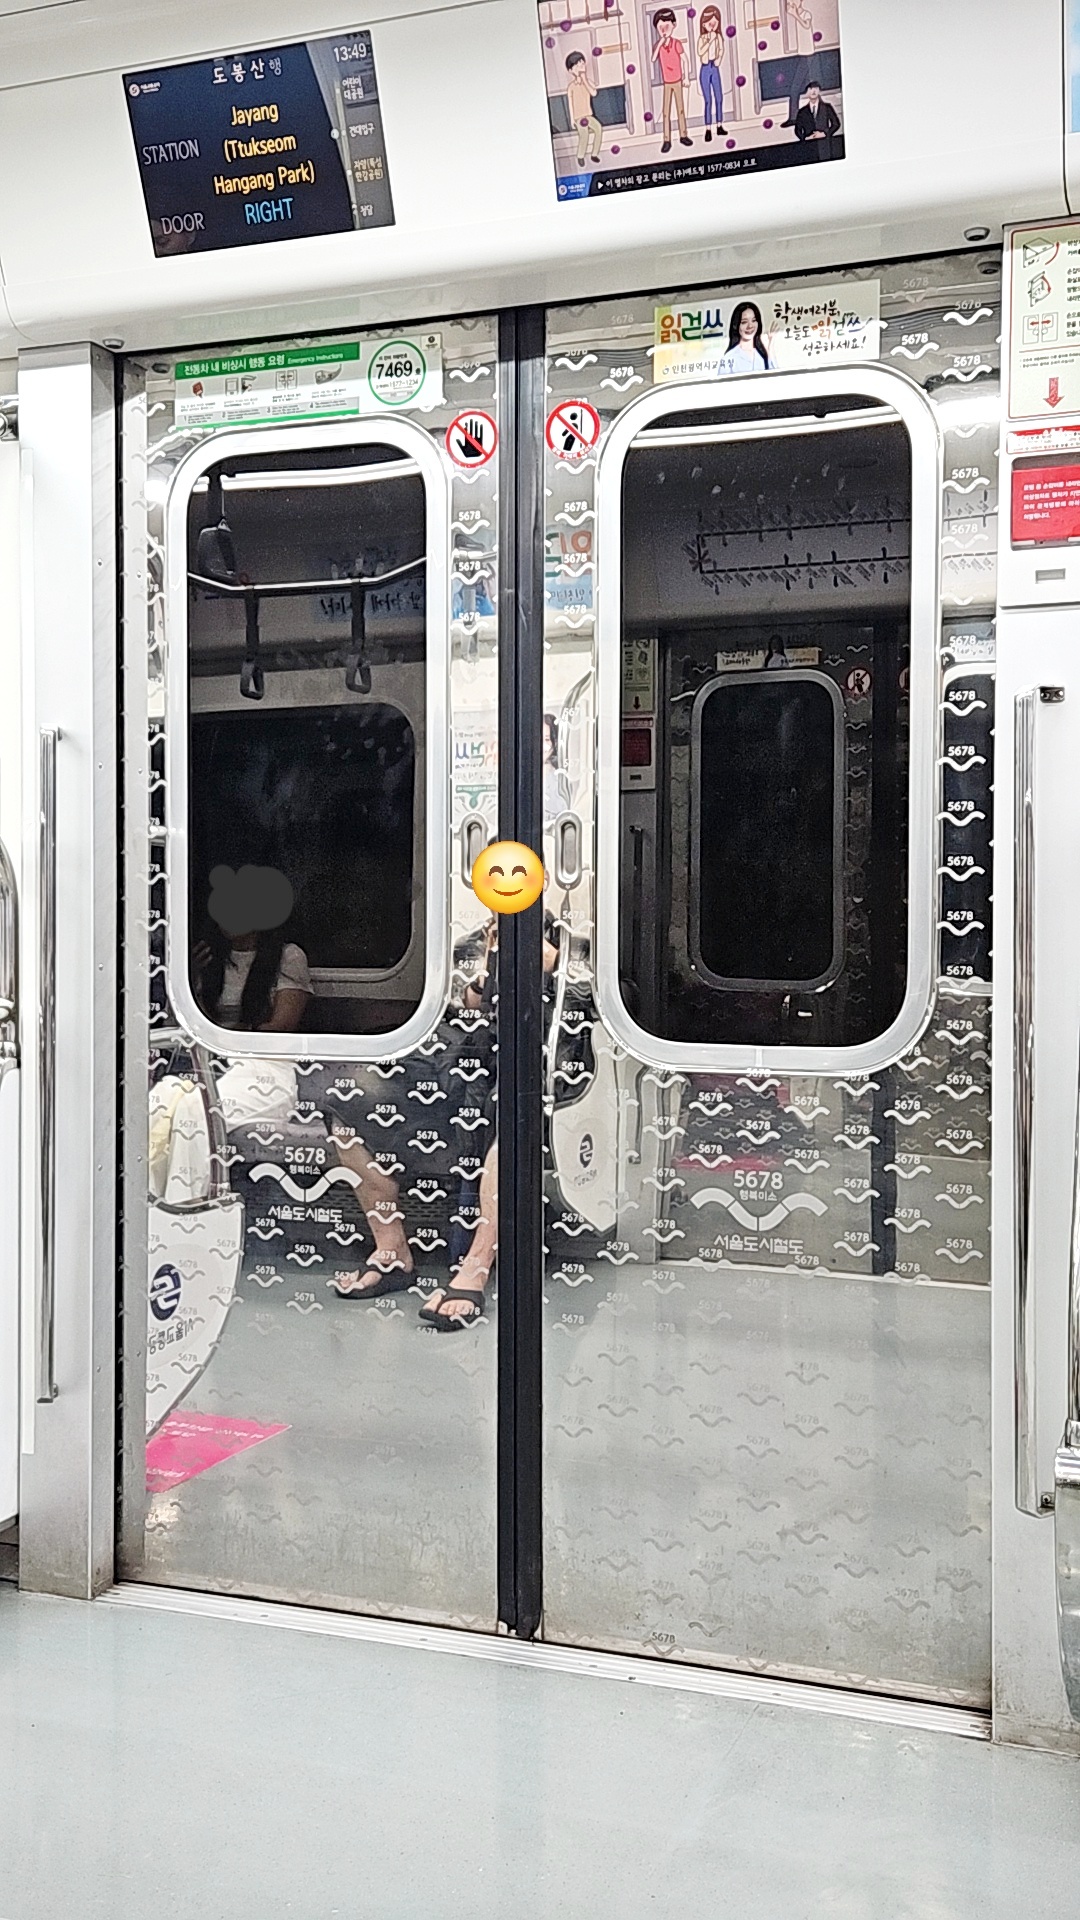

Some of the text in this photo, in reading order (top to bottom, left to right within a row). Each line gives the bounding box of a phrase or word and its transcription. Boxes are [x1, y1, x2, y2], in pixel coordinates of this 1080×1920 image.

[334, 43, 367, 62] 13:49
[342, 76, 362, 89] 어린이
[231, 103, 278, 127] Jayang
[142, 138, 200, 165] STATION
[223, 134, 297, 163] (Ttukseom
[213, 160, 315, 195] Hangang Park)
[244, 198, 293, 225] RIGHT
[160, 211, 206, 236] DOOR
[903, 277, 929, 289] 5678
[660, 308, 724, 344] 읽걷쓰
[784, 325, 811, 341] 오늘도
[901, 332, 929, 346] 5678
[802, 336, 867, 358] 성공하세요!
[953, 355, 981, 368] 5678
[184, 361, 209, 376] 전동차
[375, 360, 413, 379] 7469
[610, 366, 634, 378] 5678
[951, 467, 979, 479] 5678
[564, 502, 588, 513] 5678
[459, 511, 481, 521] 5678
[951, 524, 978, 535] 5678
[564, 553, 588, 563] 5678
[459, 561, 481, 571] 5678
[563, 604, 588, 615] 5678
[459, 613, 481, 622] 5678
[949, 635, 977, 646] 5678
[948, 690, 976, 701] 5678
[947, 746, 976, 757] 5678
[946, 801, 975, 812] 5678
[945, 856, 974, 867] 5678
[562, 910, 585, 920] 5678
[946, 911, 974, 921] 5678
[459, 960, 480, 970] 5678
[946, 966, 973, 977] 5678
[459, 1009, 481, 1019] 5678
[562, 1011, 585, 1021] 5678
[946, 1020, 973, 1031] 5678
[459, 1059, 481, 1069] 5678
[562, 1061, 585, 1071] 5678
[179, 1073, 198, 1082] 5678
[256, 1076, 276, 1085] 5678
[946, 1074, 973, 1085] 5678
[334, 1079, 355, 1089] 5678
[416, 1082, 438, 1092] 5678
[216, 1098, 237, 1107] 5678
[699, 1092, 723, 1103] 5678
[794, 1097, 819, 1107] 5678
[295, 1102, 315, 1111] 5678
[375, 1105, 396, 1115] 5678
[894, 1100, 921, 1111] 5678
[459, 1108, 481, 1118] 5678
[179, 1119, 198, 1129] 5678
[652, 1116, 676, 1126] 5678
[746, 1121, 771, 1131] 5678
[255, 1124, 276, 1133] 5678
[334, 1127, 355, 1137] 5678
[844, 1125, 870, 1135] 5678
[416, 1131, 438, 1141] 5678
[946, 1129, 973, 1140] 5678
[216, 1145, 237, 1155] 5678
[699, 1145, 723, 1154] 5678
[284, 1146, 326, 1164] 5678
[375, 1153, 396, 1163] 5678
[794, 1150, 819, 1160] 5678
[894, 1154, 921, 1165] 5678
[459, 1157, 481, 1167] 5678
[652, 1168, 676, 1178] 5678
[733, 1169, 783, 1190] 5678
[844, 1179, 870, 1189] 5678
[416, 1180, 438, 1190] 5678
[946, 1184, 973, 1195] 5678
[375, 1202, 396, 1212] 5678
[459, 1207, 481, 1217] 5678
[267, 1205, 342, 1222] 서울도시철도
[562, 1213, 584, 1223] 5678
[894, 1209, 921, 1220] 5678
[255, 1218, 276, 1228] 5678
[334, 1223, 355, 1233] 5678
[652, 1219, 676, 1229] 5678
[416, 1229, 438, 1239] 5678
[844, 1232, 870, 1242] 5678
[216, 1240, 236, 1249] 5678
[295, 1245, 315, 1254] 5678
[606, 1241, 630, 1252] 5678
[713, 1234, 803, 1255] 서울도시철도
[946, 1239, 973, 1250] 5678
[699, 1248, 723, 1258] 5678
[179, 1260, 198, 1269] 5678
[794, 1256, 819, 1265] 5678
[255, 1265, 276, 1275] 5678
[562, 1263, 584, 1273] 5678
[894, 1262, 921, 1273] 5678
[652, 1270, 676, 1280] 5678
[416, 1278, 438, 1288] 5678
[295, 1293, 315, 1302] 5678
[375, 1299, 396, 1309] 5678
[178, 1307, 198, 1316] 5678
[562, 1314, 584, 1324] 5678
[178, 1353, 198, 1362] 5678
[651, 1632, 676, 1644] 5678
